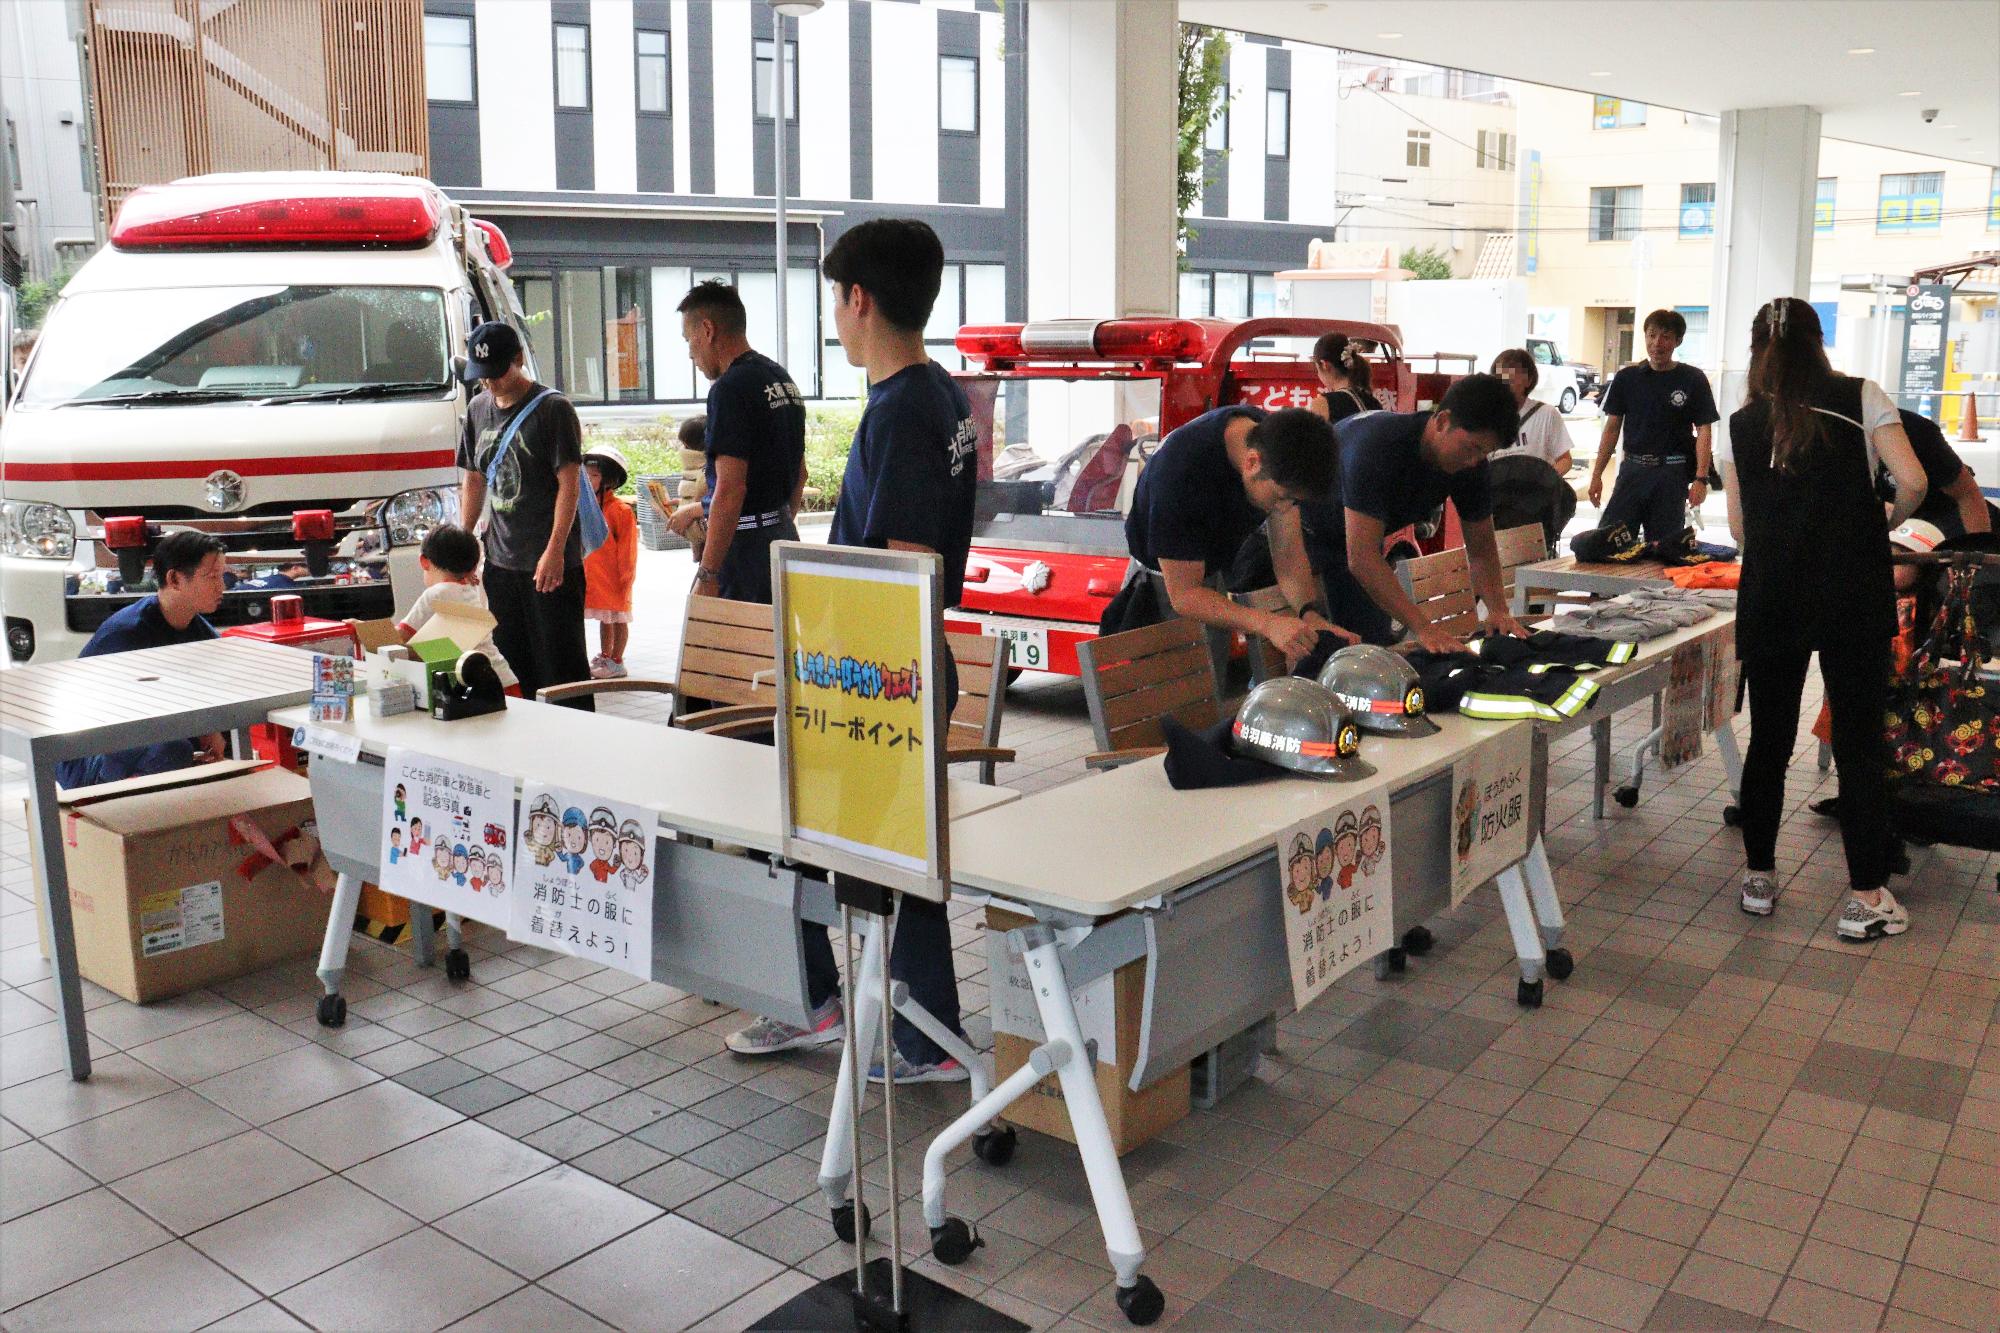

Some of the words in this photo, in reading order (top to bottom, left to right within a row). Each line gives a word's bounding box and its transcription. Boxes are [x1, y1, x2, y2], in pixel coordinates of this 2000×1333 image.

[794, 704, 923, 753] ラリーポイント
[401, 765, 493, 800] こども消防車と救急車と
[422, 792, 461, 815] 記念写真
[1480, 793, 1523, 845] 防火服
[533, 881, 633, 926] 消防士の服に
[1302, 894, 1375, 953] 消防士の服に
